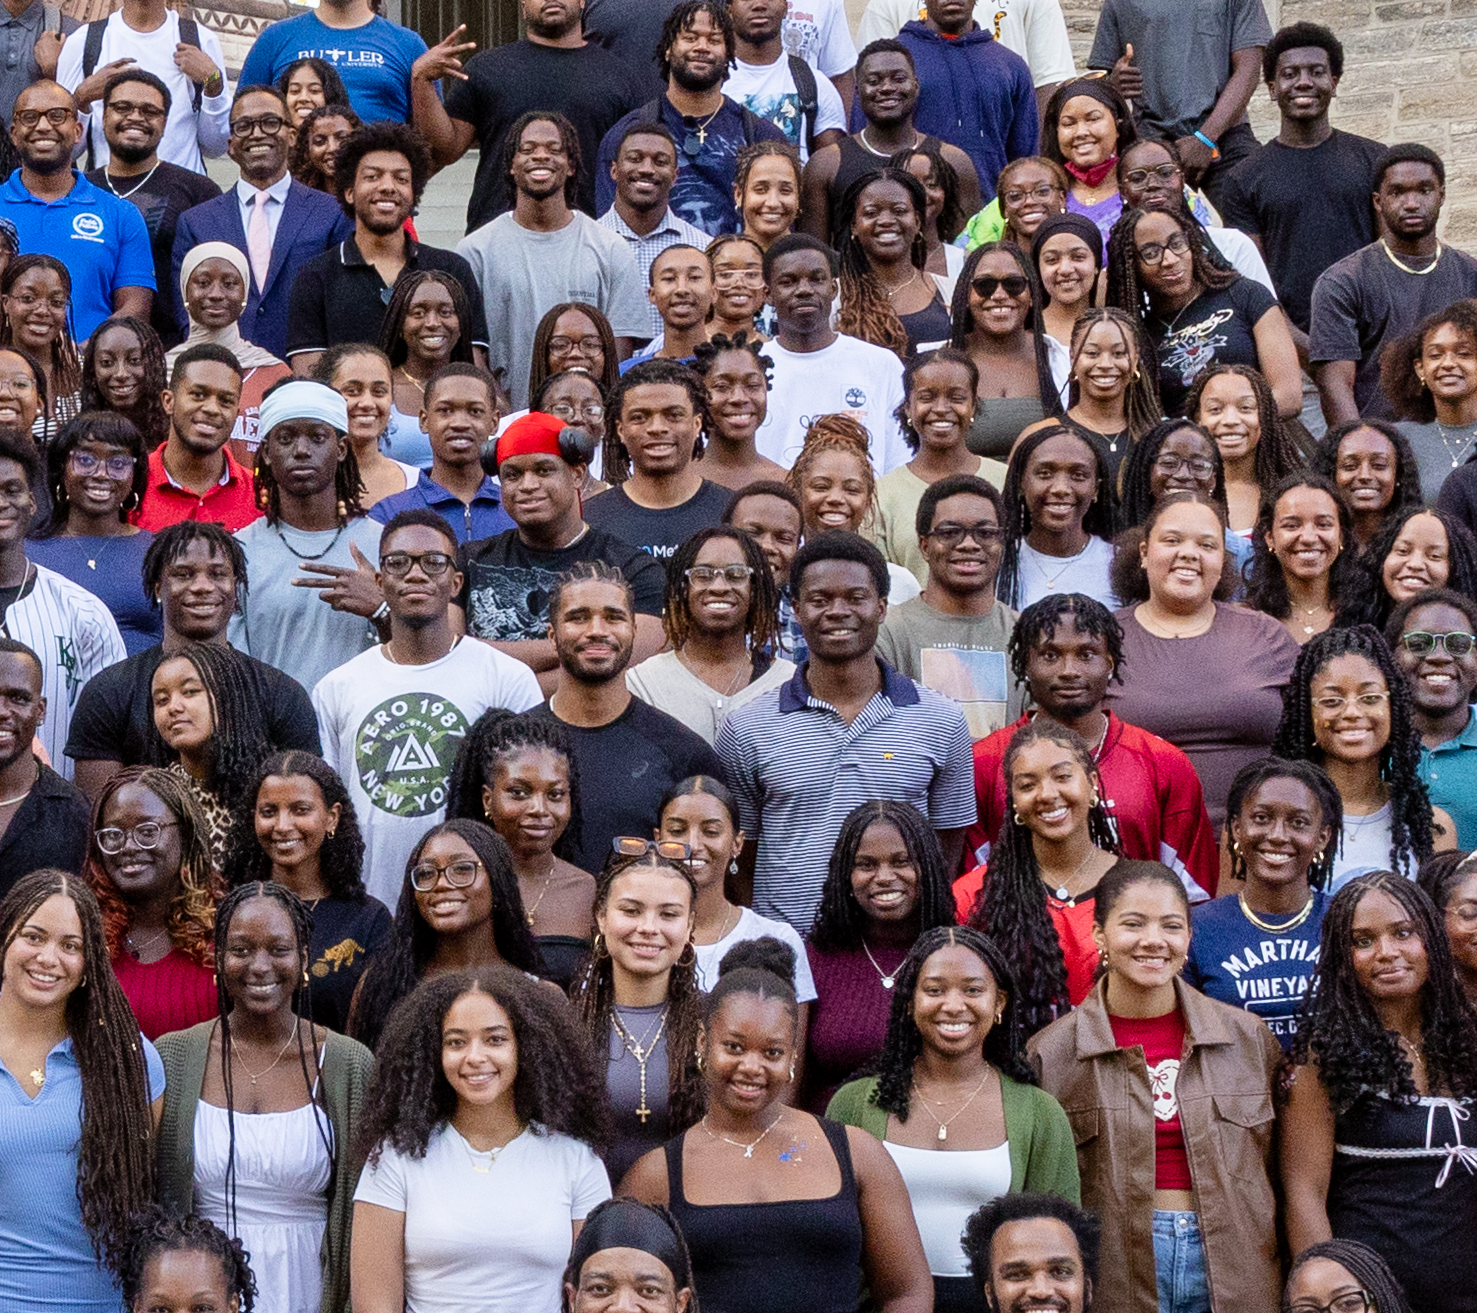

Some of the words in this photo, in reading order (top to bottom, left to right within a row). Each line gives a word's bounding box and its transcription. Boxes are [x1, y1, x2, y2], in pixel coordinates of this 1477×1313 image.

[360, 700, 408, 755] AERO
[420, 698, 466, 738] 1987
[362, 768, 405, 811] NEW
[400, 775, 430, 785] U.S.A.
